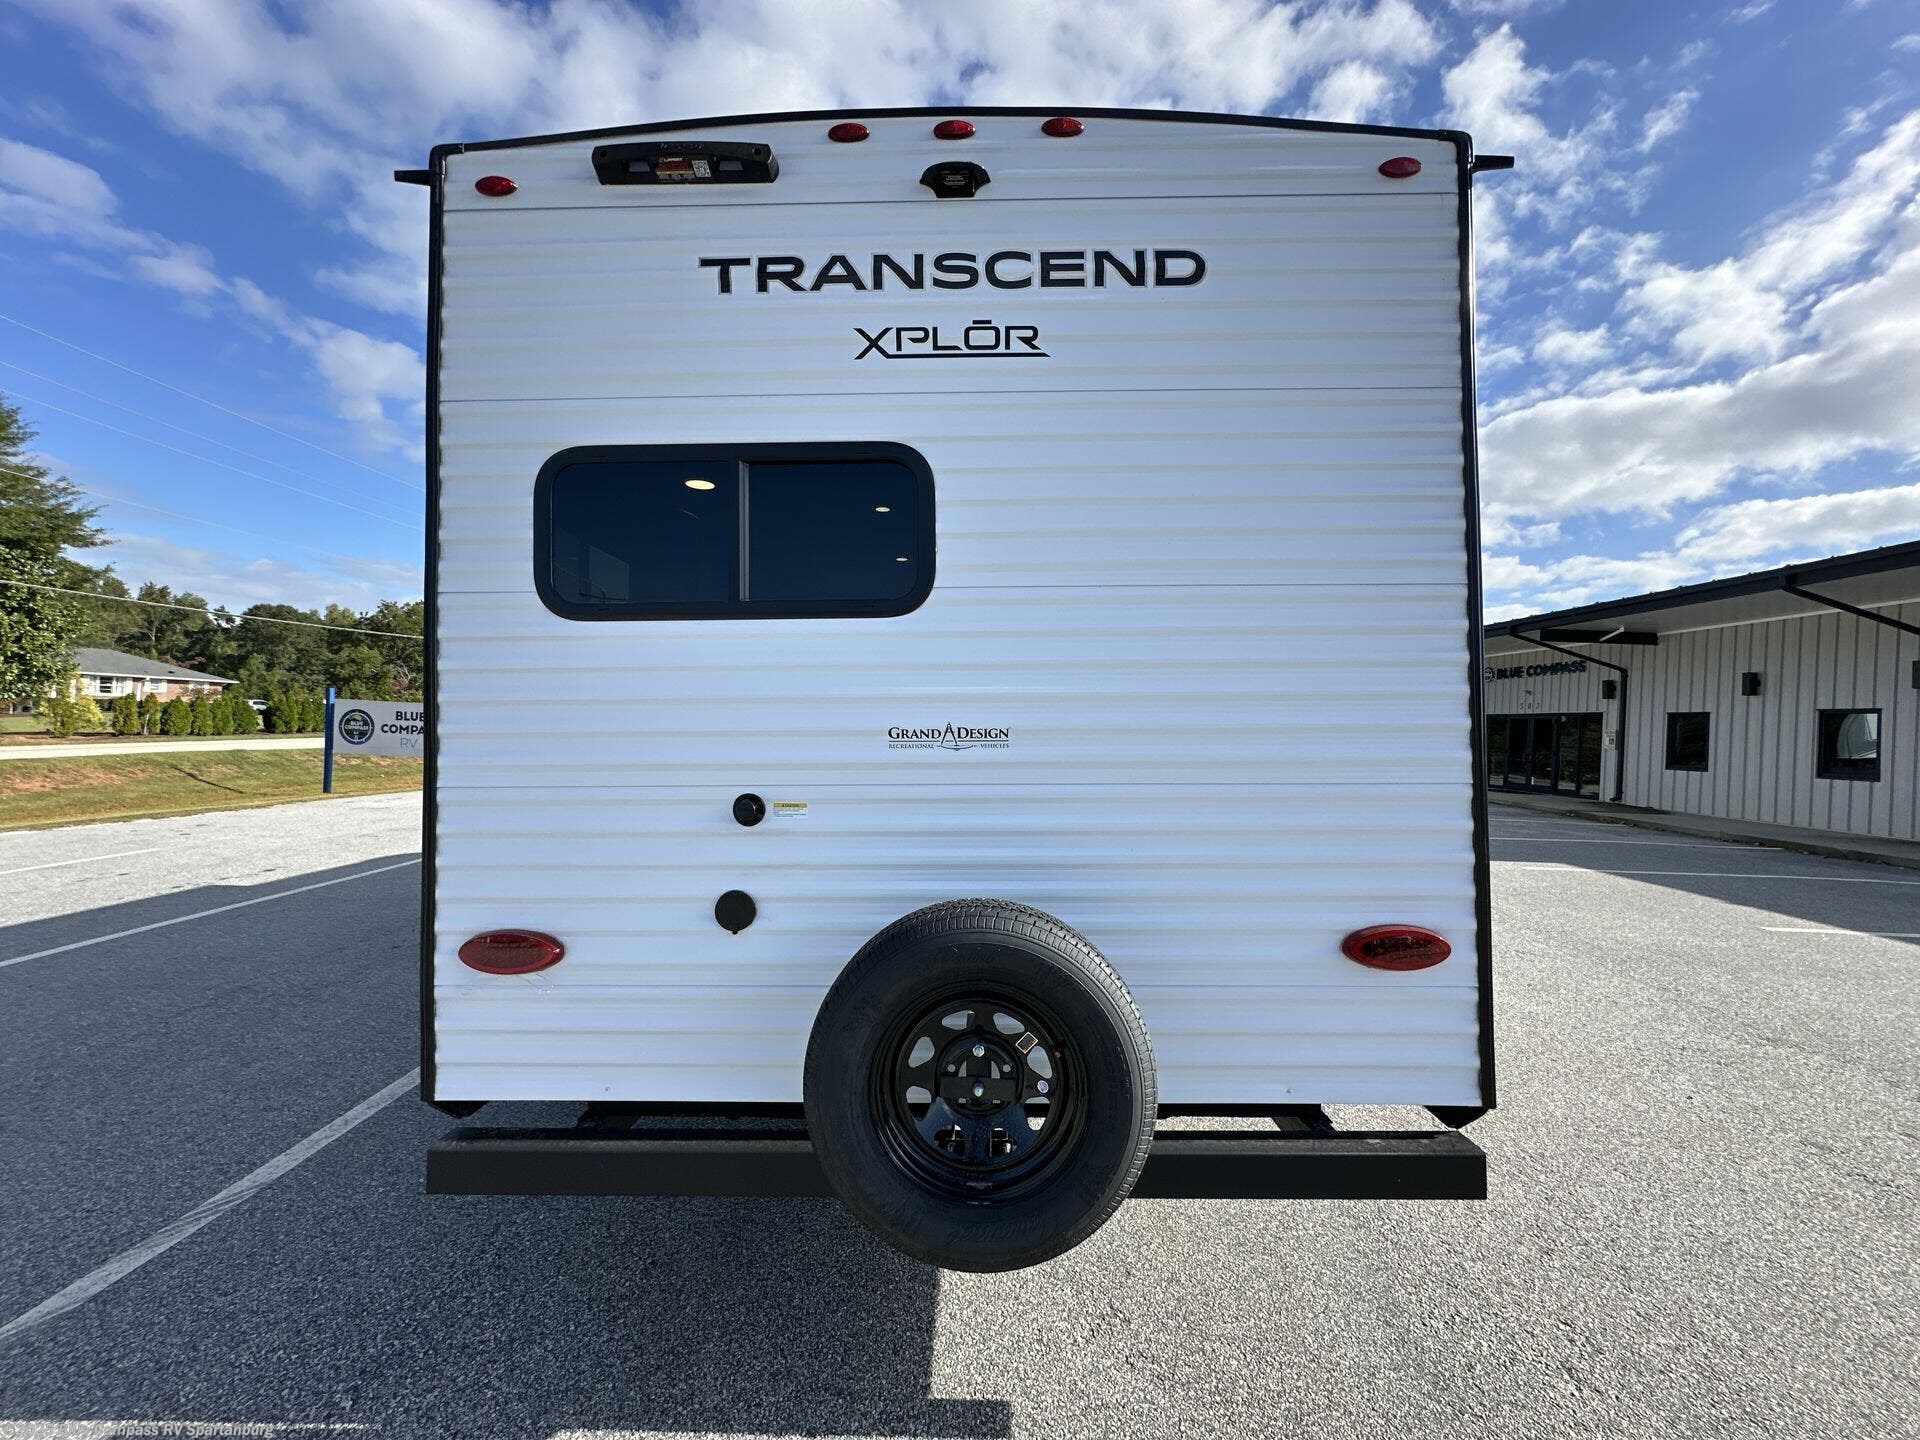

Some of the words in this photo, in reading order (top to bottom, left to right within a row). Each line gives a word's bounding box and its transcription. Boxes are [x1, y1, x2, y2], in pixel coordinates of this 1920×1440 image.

[699, 248, 1208, 295] TRANSCEND
[1496, 666, 1524, 680] BLUE
[1526, 660, 1587, 677] COMPASS
[396, 711, 424, 721] BLUE
[381, 724, 424, 735] COMPA
[888, 727, 941, 739] GRAND
[957, 727, 1009, 739] DESIGN
[400, 738, 418, 748] RV
